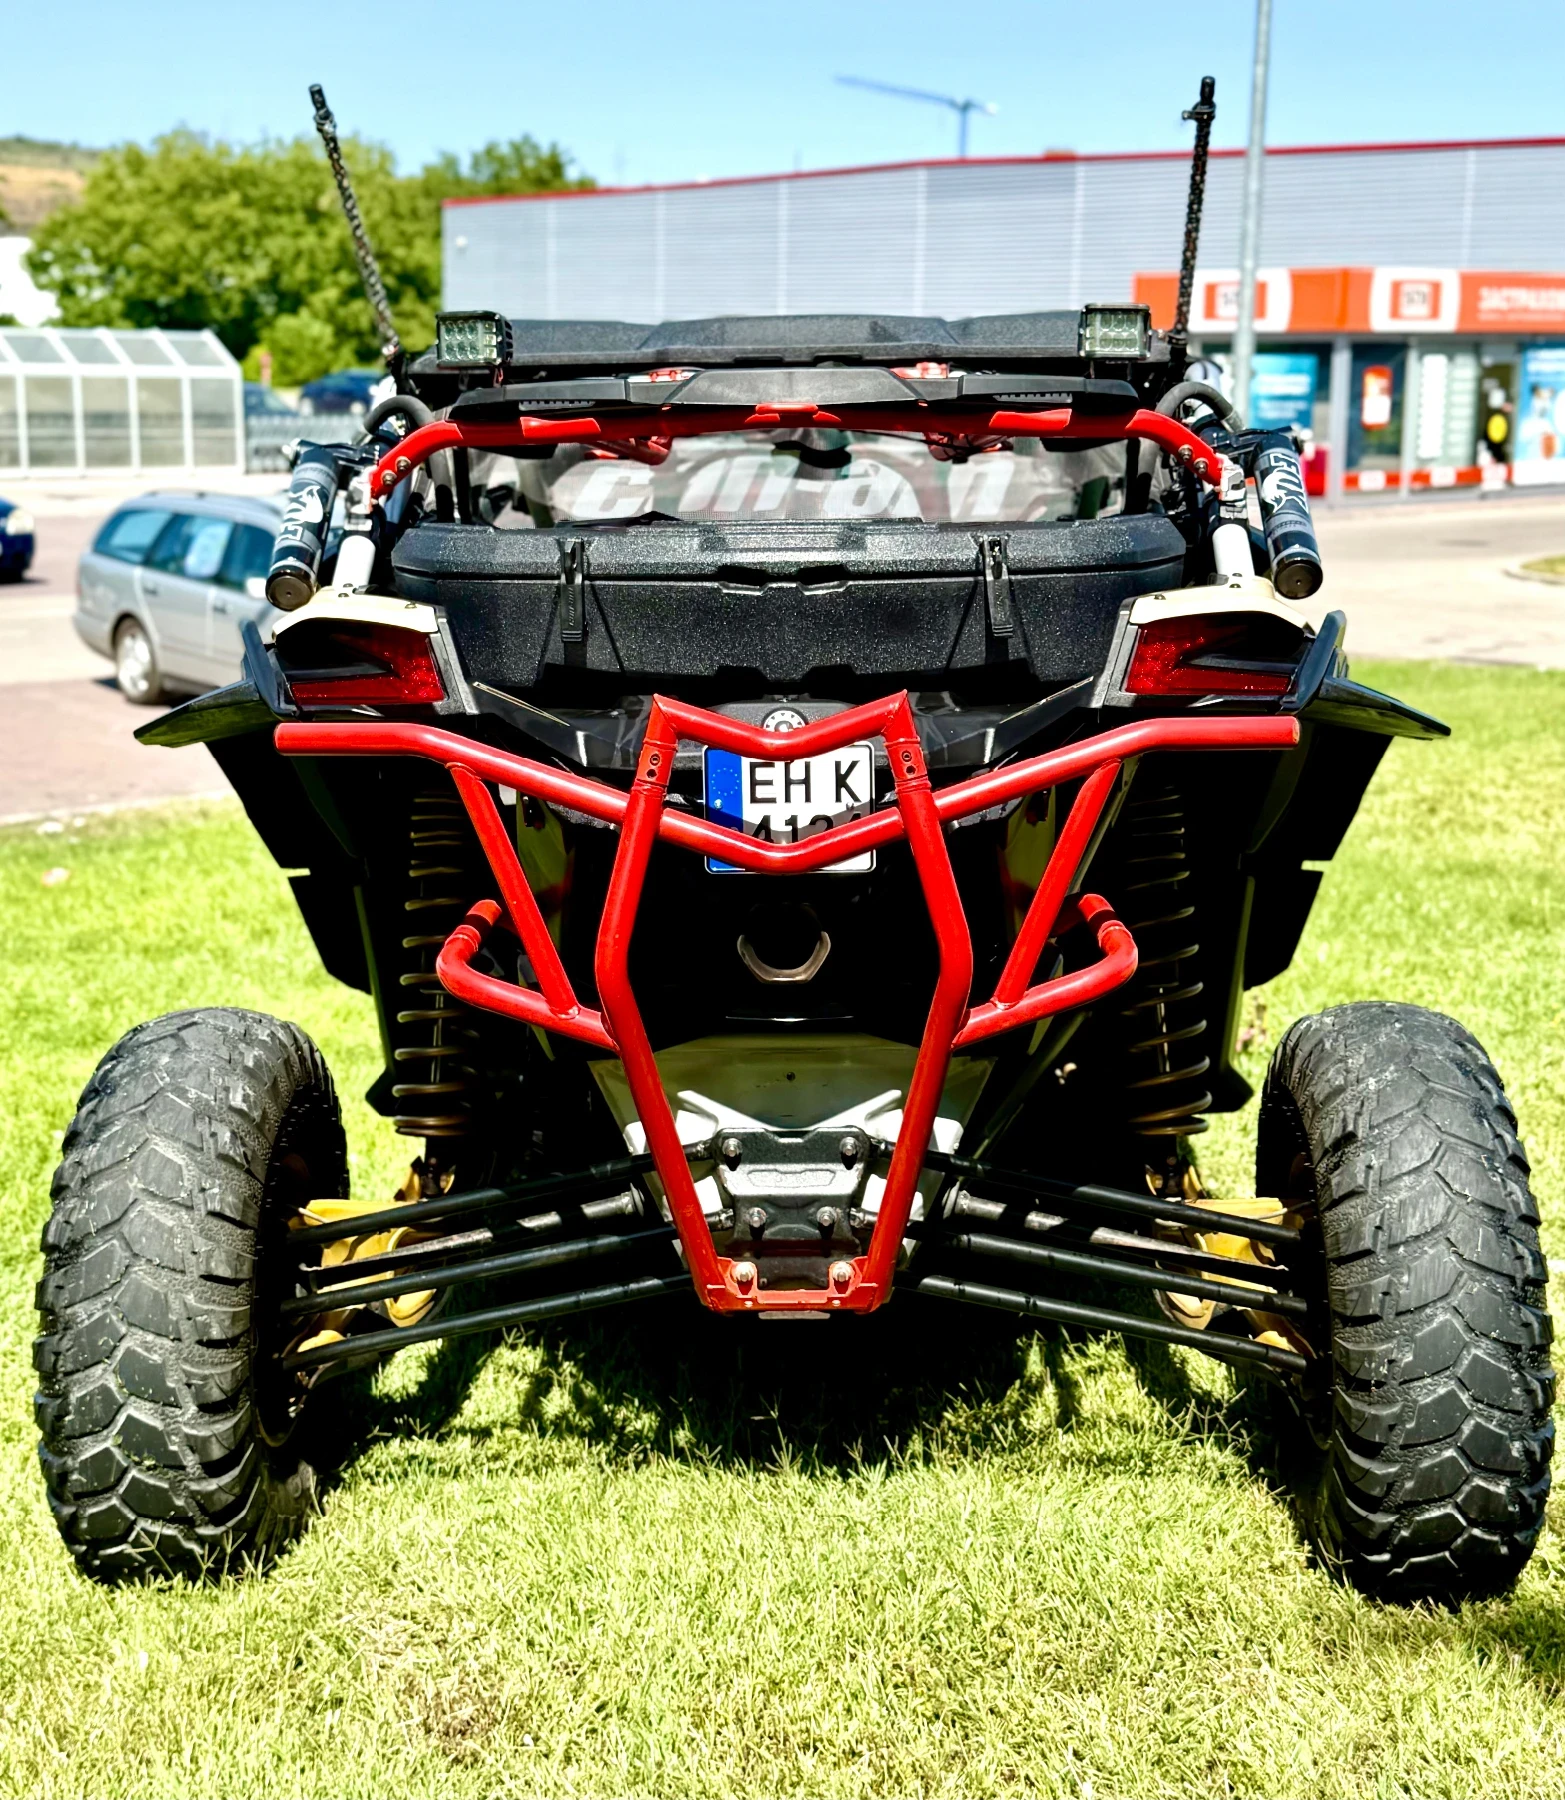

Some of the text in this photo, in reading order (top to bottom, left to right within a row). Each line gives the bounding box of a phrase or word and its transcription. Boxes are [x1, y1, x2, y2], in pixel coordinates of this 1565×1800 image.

[1262, 452, 1310, 514] FOX
[275, 485, 324, 542] FOX
[749, 760, 862, 805] EH K
